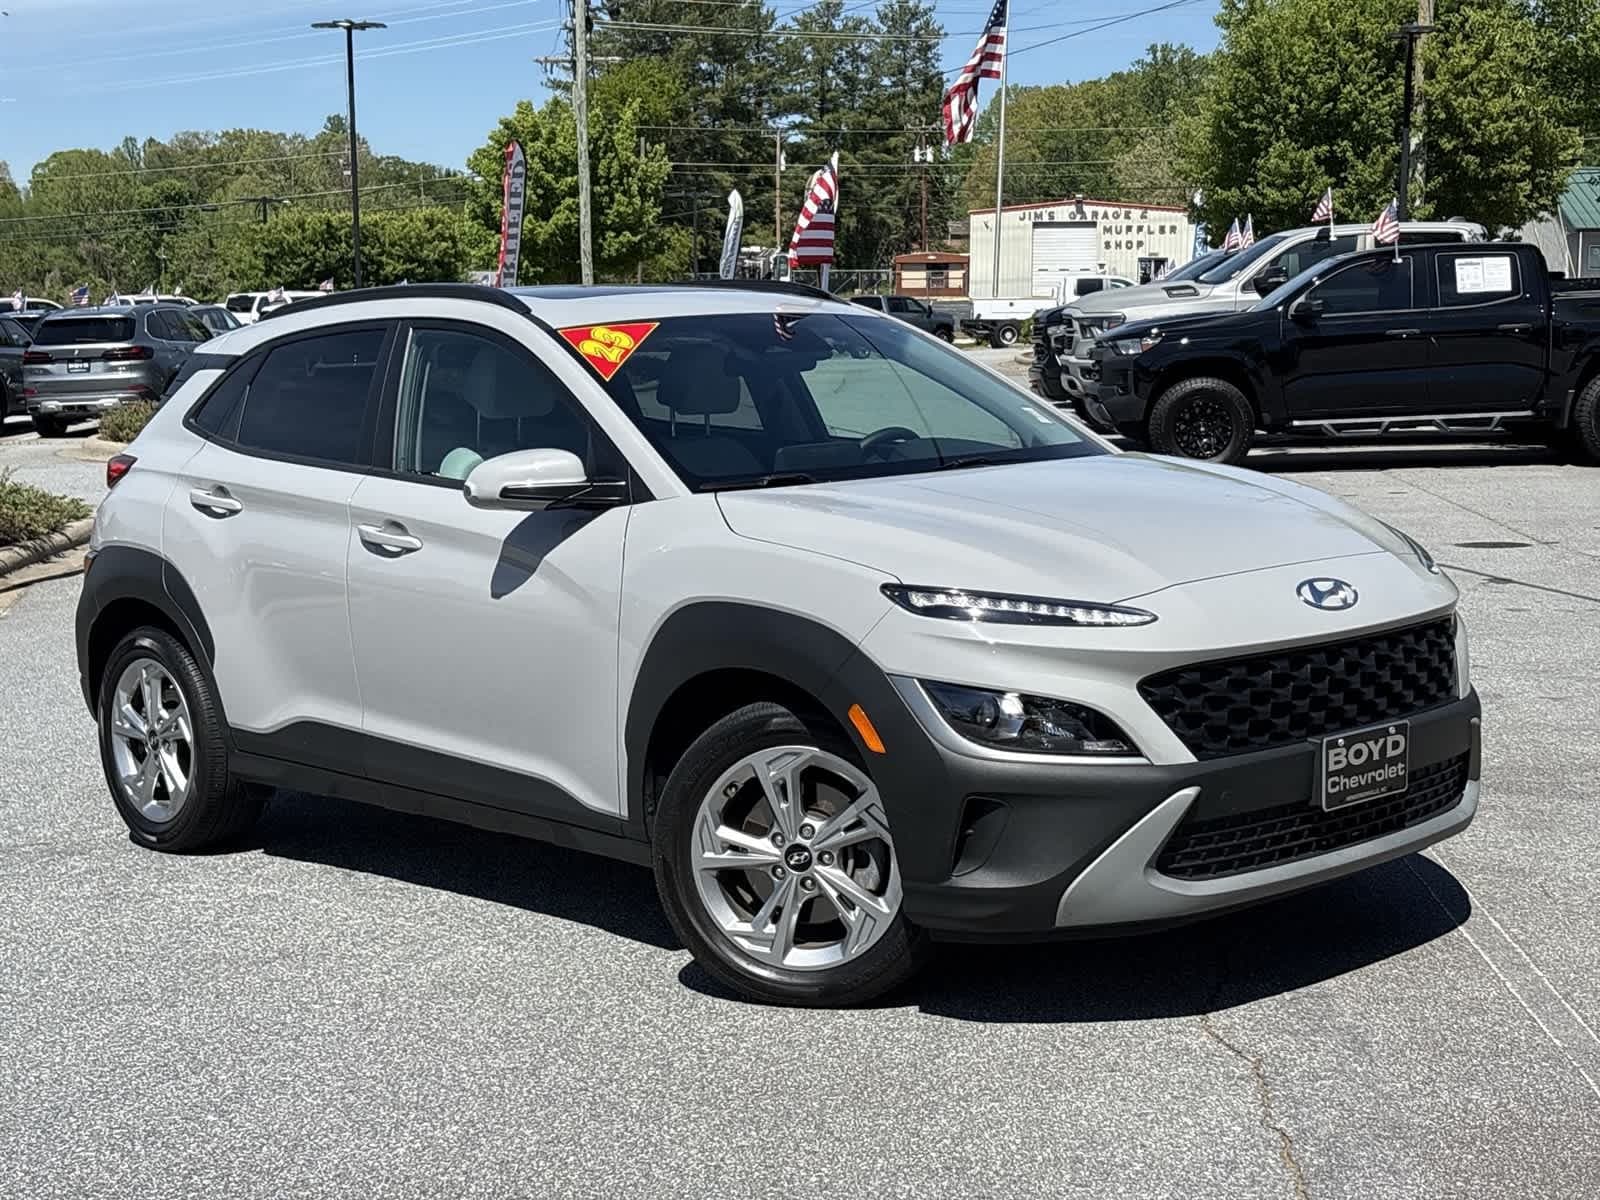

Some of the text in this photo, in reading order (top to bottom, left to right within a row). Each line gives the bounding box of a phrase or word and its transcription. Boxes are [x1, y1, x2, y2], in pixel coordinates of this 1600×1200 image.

[1019, 210, 1055, 221] JIM'S
[1068, 210, 1131, 220] GARAGE
[1103, 225, 1177, 235] MUFFLER
[1104, 240, 1144, 250] SHOP
[580, 326, 634, 363] 23
[1327, 734, 1405, 772] BOYD
[1327, 762, 1405, 793] Chevrolet
